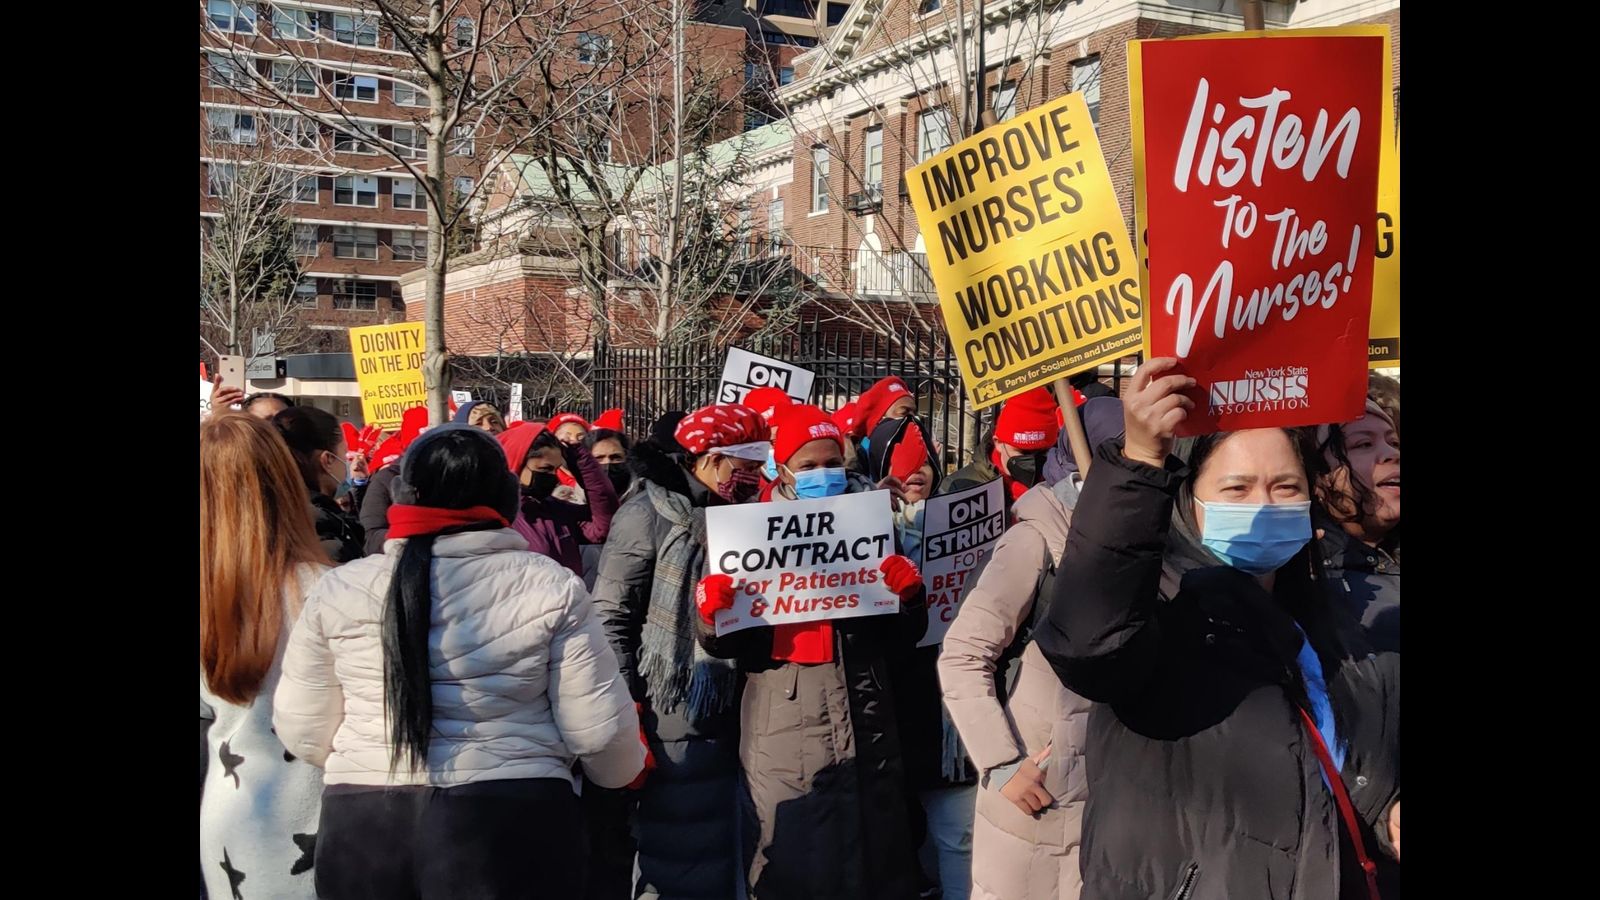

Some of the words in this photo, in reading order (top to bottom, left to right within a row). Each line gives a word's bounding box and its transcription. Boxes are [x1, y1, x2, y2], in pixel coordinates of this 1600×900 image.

[1174, 77, 1361, 192] listen
[921, 105, 1080, 212] IMPROVE
[937, 161, 1086, 266] NURSES'
[955, 231, 1121, 331] WORKING
[1166, 225, 1361, 359] Nurses!
[360, 329, 420, 354] DIGNITY
[964, 278, 1142, 379] CONDITIONS
[360, 357, 378, 374] ON
[379, 355, 404, 373] THE
[1005, 374, 1027, 388] Party
[1028, 369, 1041, 379] for
[1040, 354, 1083, 374] Socialism
[1084, 346, 1101, 359] and
[1101, 332, 1142, 352] Liberatio
[1244, 369, 1265, 380] New
[1266, 367, 1286, 378] York
[1287, 366, 1308, 376] State
[364, 389, 377, 401] for
[378, 381, 428, 399] ESSENTI
[750, 365, 788, 392] ON
[976, 382, 1002, 402] PSL
[1209, 375, 1309, 407] NURSES
[373, 400, 429, 420] WORK
[1208, 398, 1309, 416] ASSOCIATION
[951, 495, 985, 524] ON
[767, 511, 835, 541] FAIR
[928, 514, 1003, 558] STRIKE
[719, 533, 890, 574] CONTRACT
[780, 566, 878, 593] Patients
[932, 569, 976, 592] BET
[750, 598, 769, 618] &
[772, 594, 860, 616] Nurses
